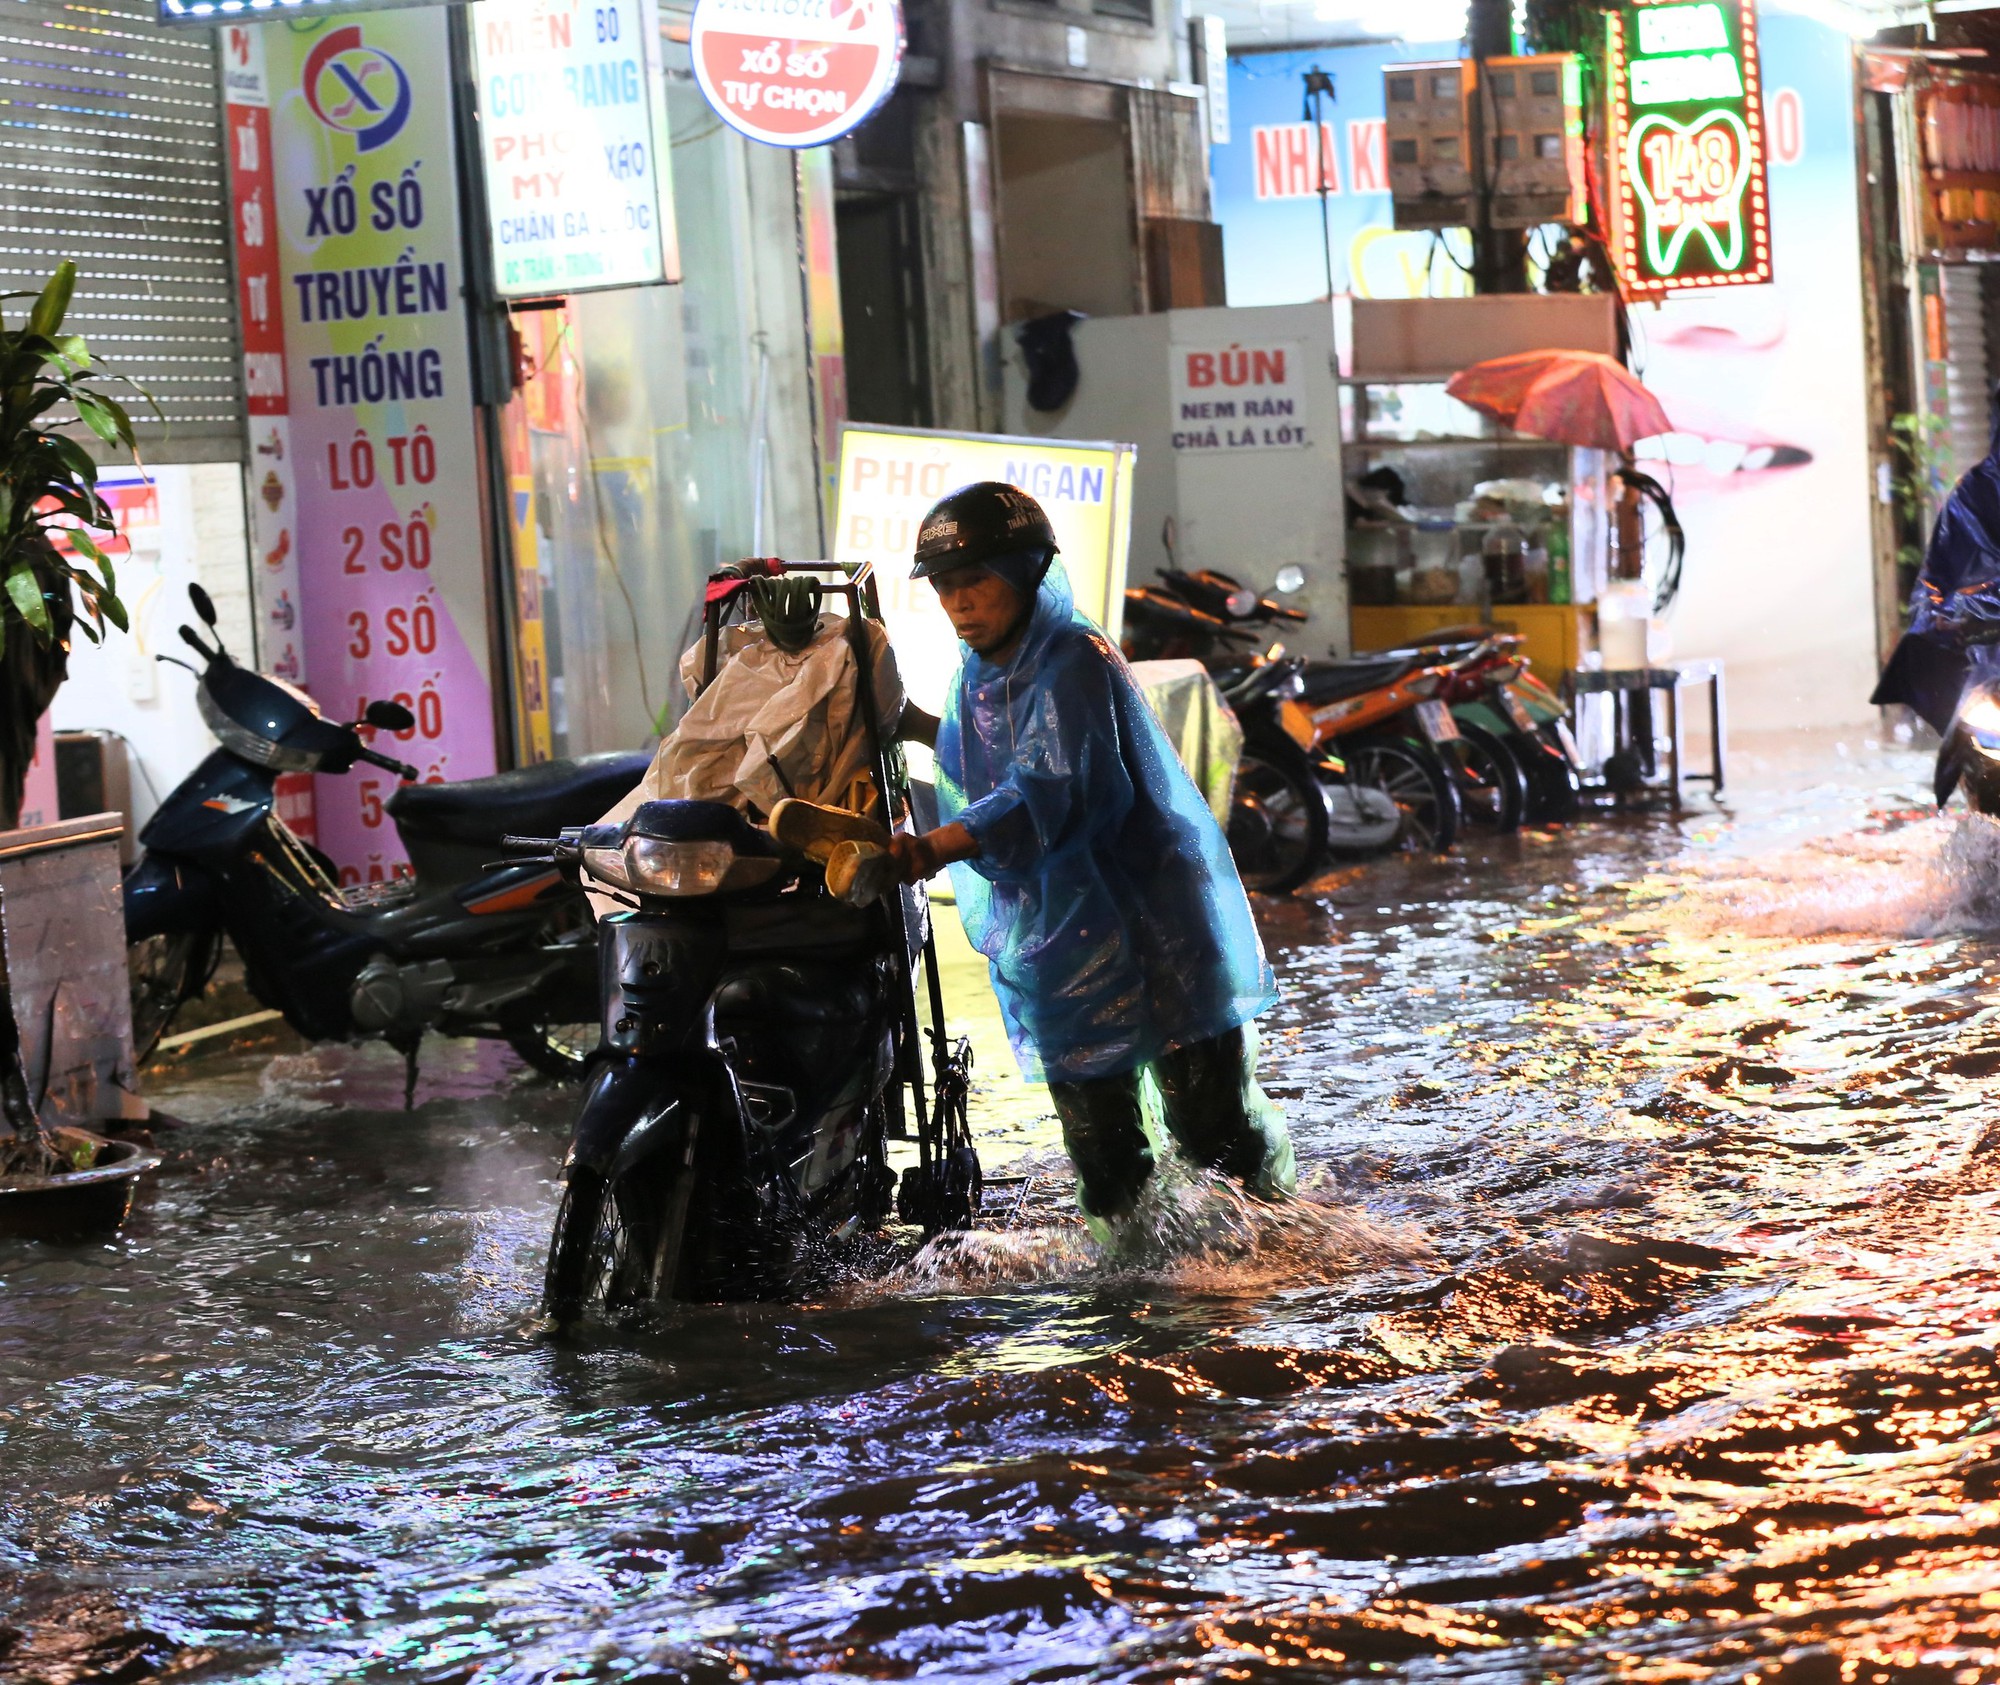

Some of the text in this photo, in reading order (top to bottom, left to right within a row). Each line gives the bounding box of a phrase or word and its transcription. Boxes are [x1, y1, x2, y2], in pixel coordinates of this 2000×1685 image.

[739, 41, 830, 78] XỔ SỐ
[722, 80, 846, 116] TỰ CHỌN
[1644, 128, 1734, 200] 148
[304, 160, 424, 237] XỔ SỐ
[294, 246, 447, 323] TRUYỀN
[310, 333, 443, 406] THỐNG
[1187, 342, 1286, 388] BÚN
[1181, 396, 1294, 421] NEM RÁN
[328, 424, 437, 491] LÔ TÔ
[852, 446, 1104, 504] PHỞ NGAN
[343, 502, 431, 575] 2 SỐ
[848, 509, 922, 554] BÚ
[920, 521, 958, 544] AXE
[348, 587, 437, 660] 3 SỐ
[392, 671, 443, 742] SỐ
[360, 780, 382, 828] 5
